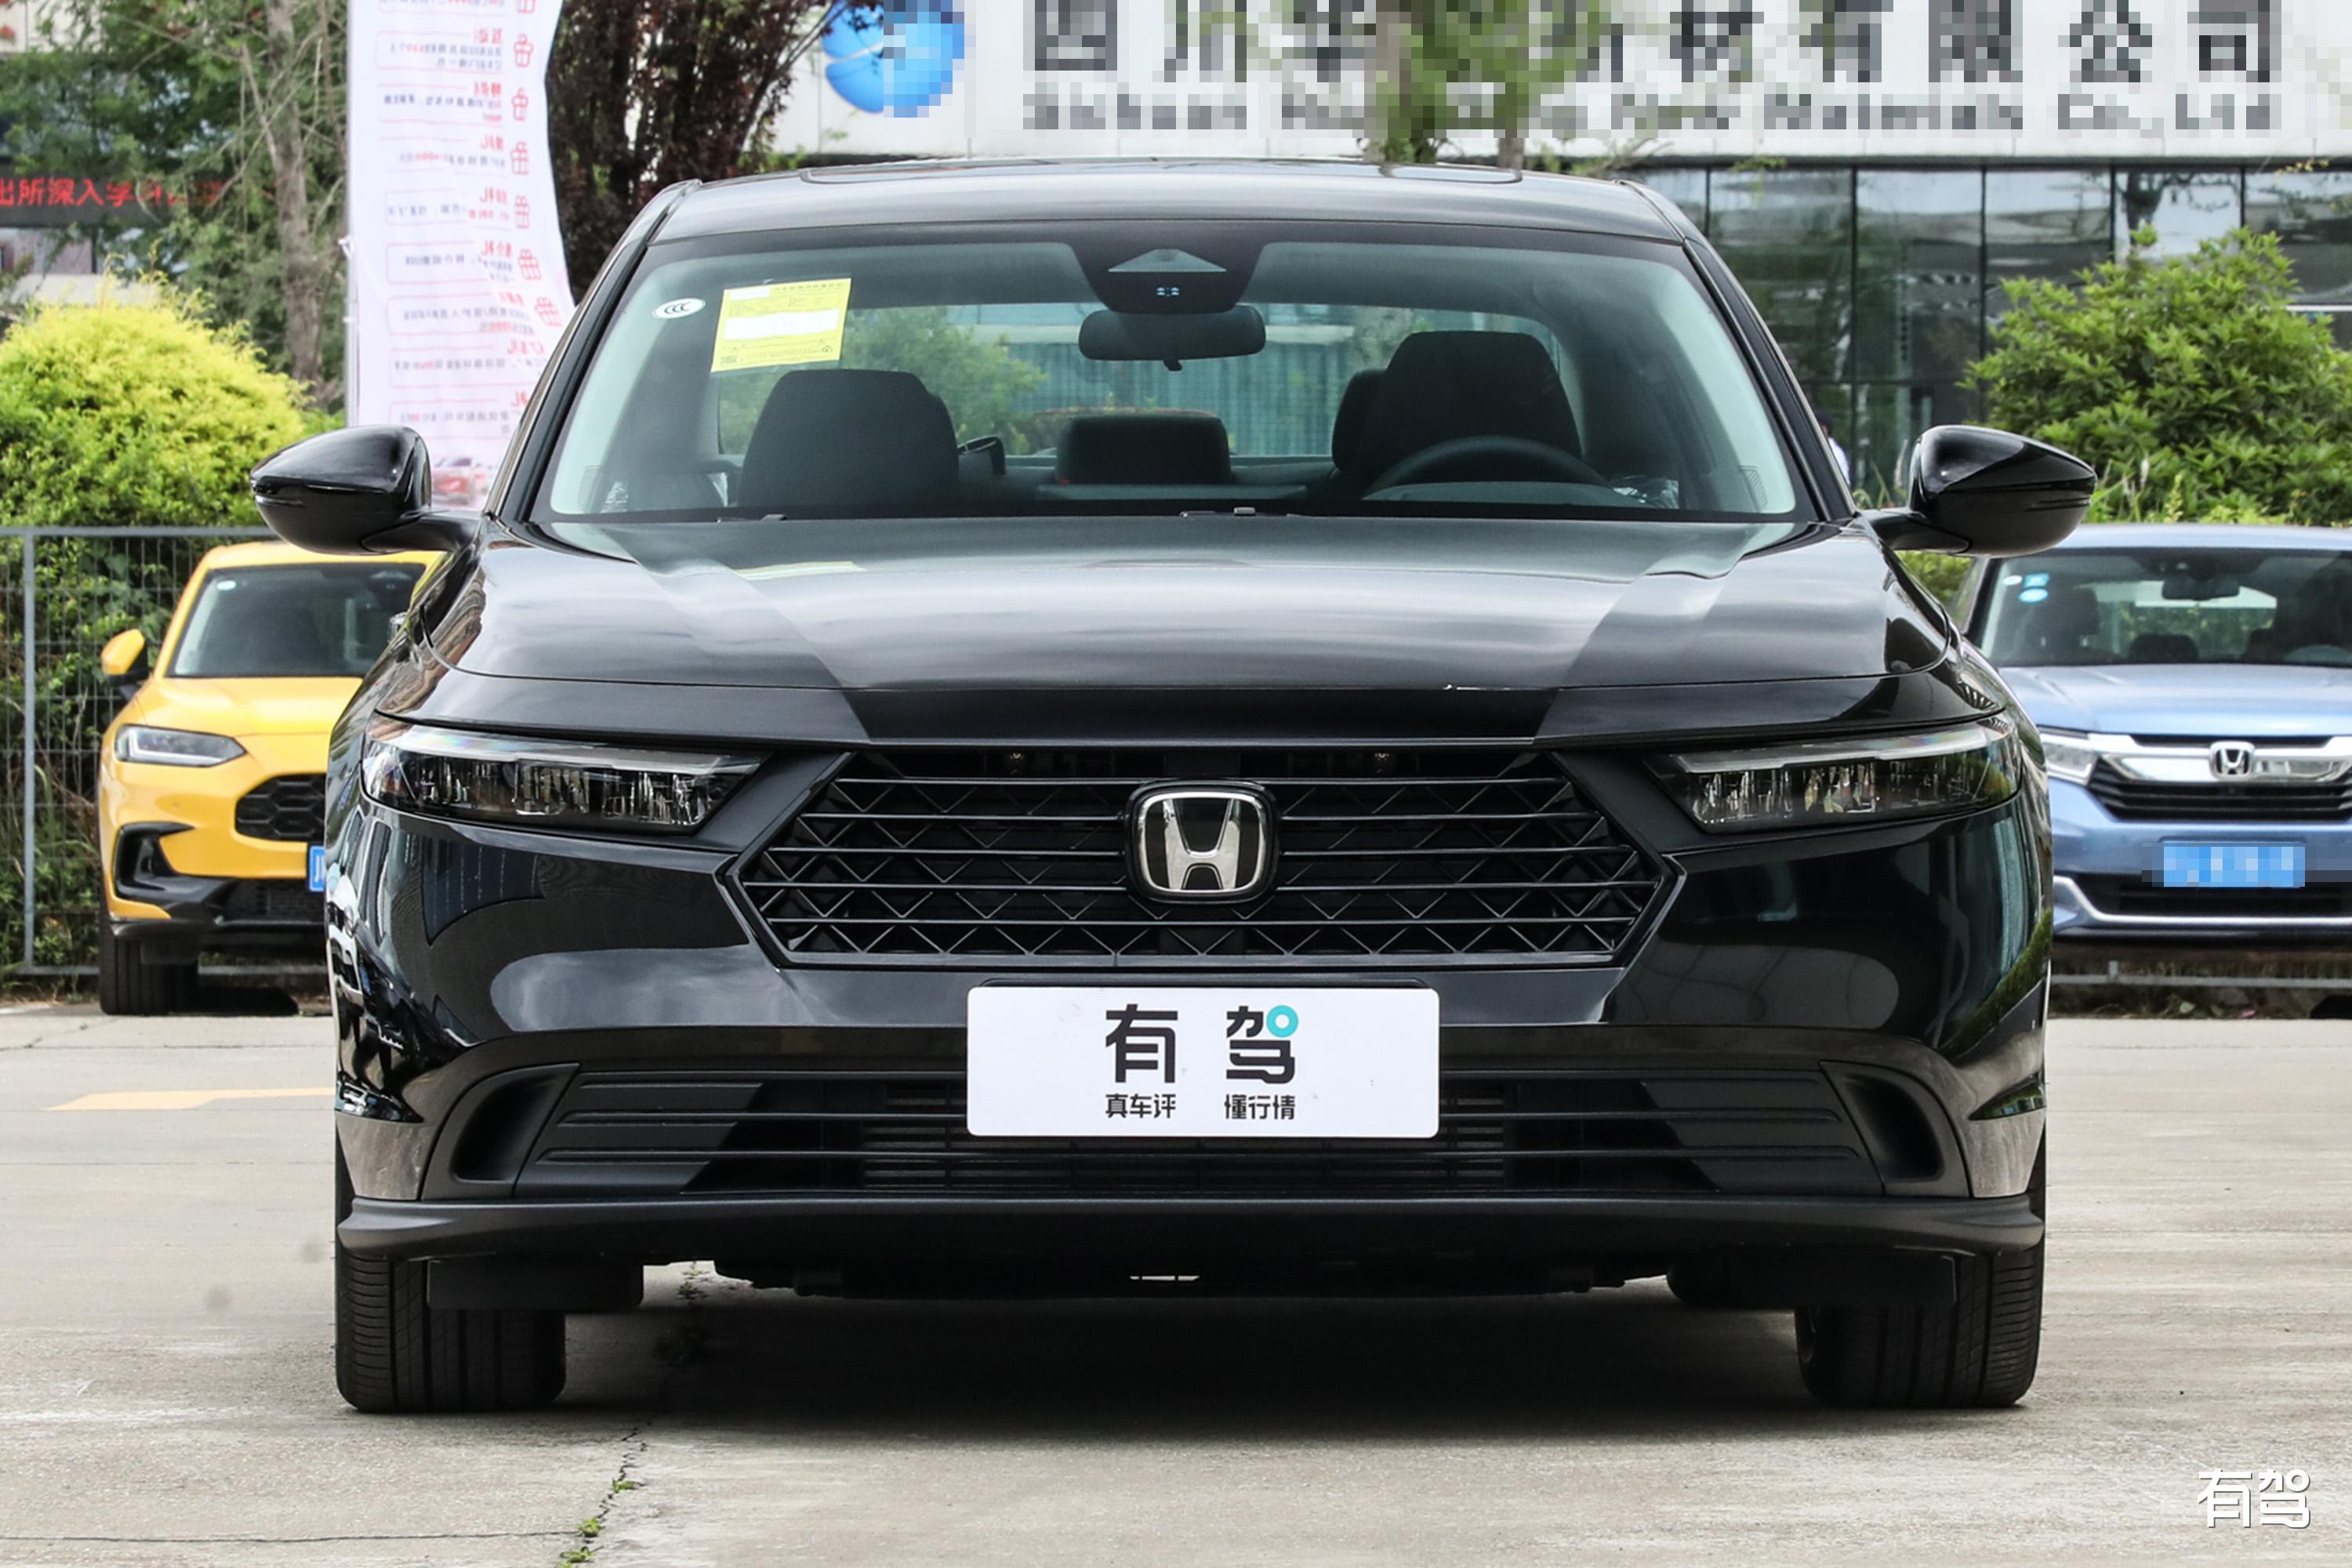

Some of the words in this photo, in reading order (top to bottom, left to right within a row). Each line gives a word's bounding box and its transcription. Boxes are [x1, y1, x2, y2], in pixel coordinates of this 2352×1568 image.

[1105, 1093, 1177, 1119] 真车评
[1224, 1094, 1296, 1120] 懂行情
